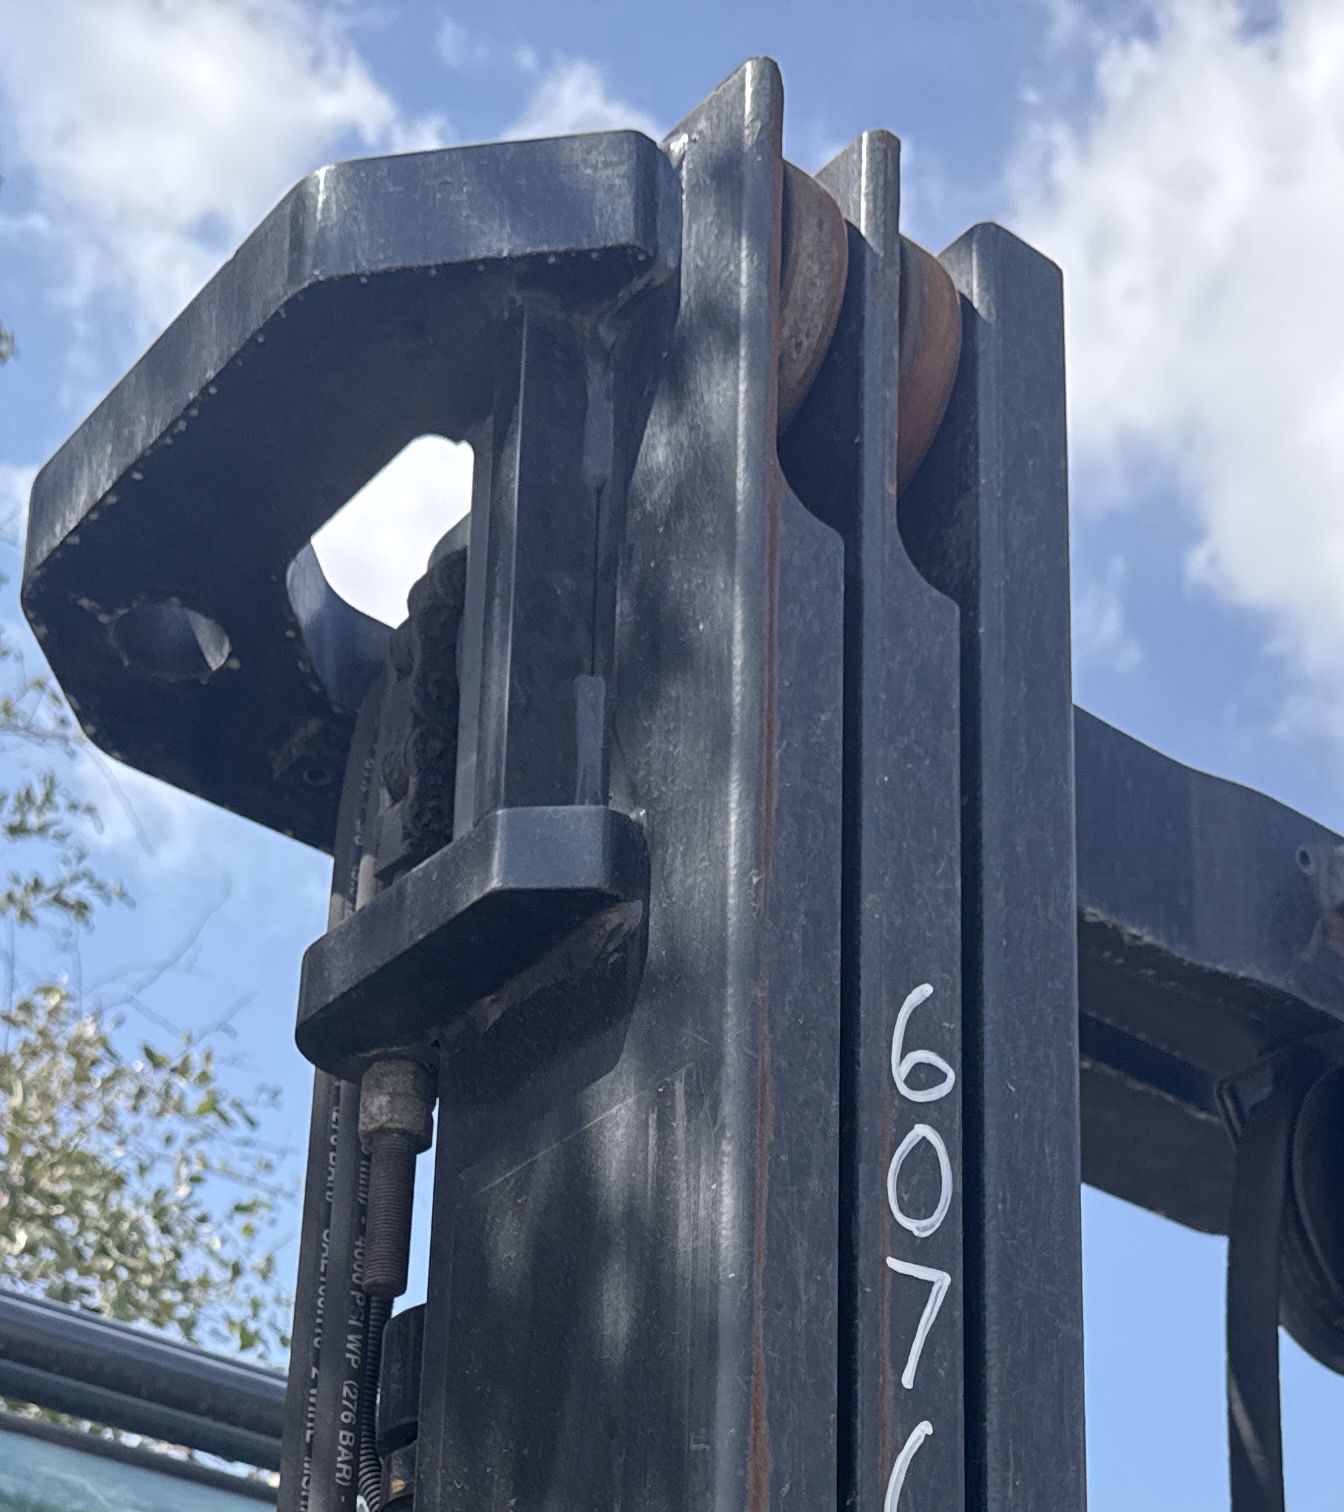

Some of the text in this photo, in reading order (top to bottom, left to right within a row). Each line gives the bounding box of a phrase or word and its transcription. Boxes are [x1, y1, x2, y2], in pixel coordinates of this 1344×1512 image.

[345, 1333, 363, 1370] WP
[339, 1379, 359, 1426] (276
[334, 1429, 356, 1487] BAR)
